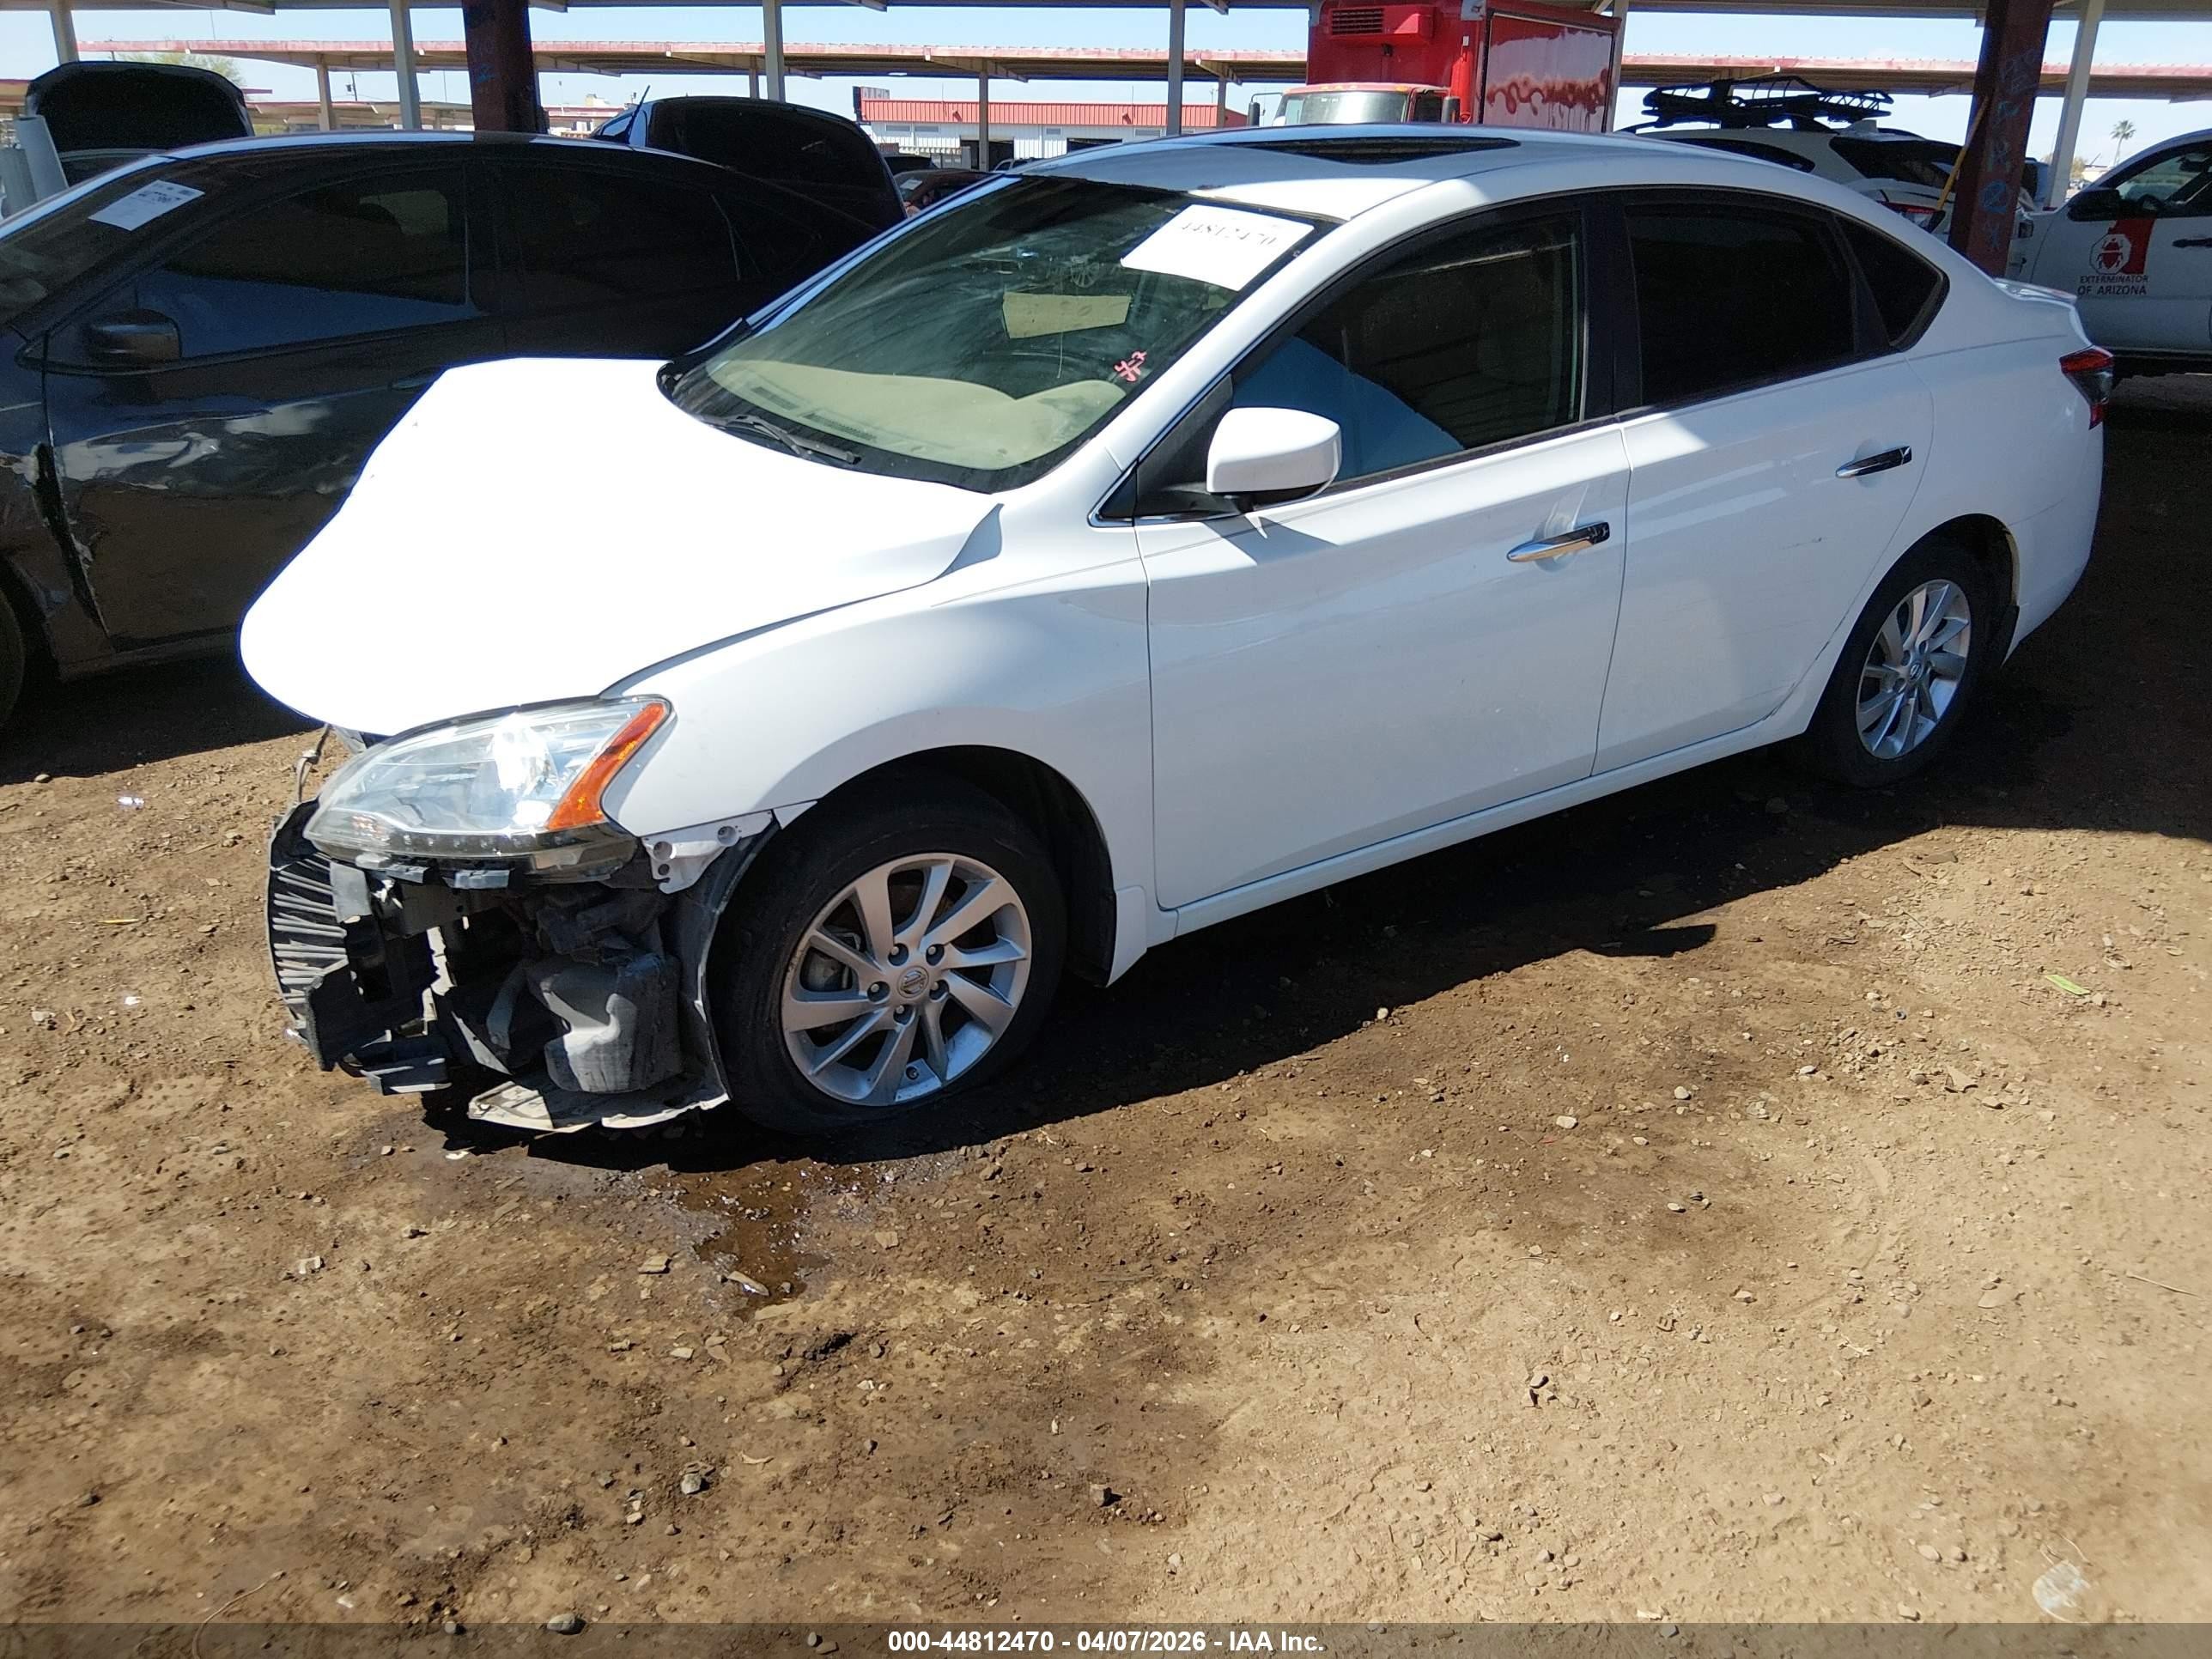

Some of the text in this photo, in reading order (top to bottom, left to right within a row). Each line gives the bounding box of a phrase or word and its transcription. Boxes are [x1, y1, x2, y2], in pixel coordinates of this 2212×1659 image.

[2080, 275, 2149, 284] EXTERMINATOR
[2077, 285, 2147, 295] OF ARIZONA
